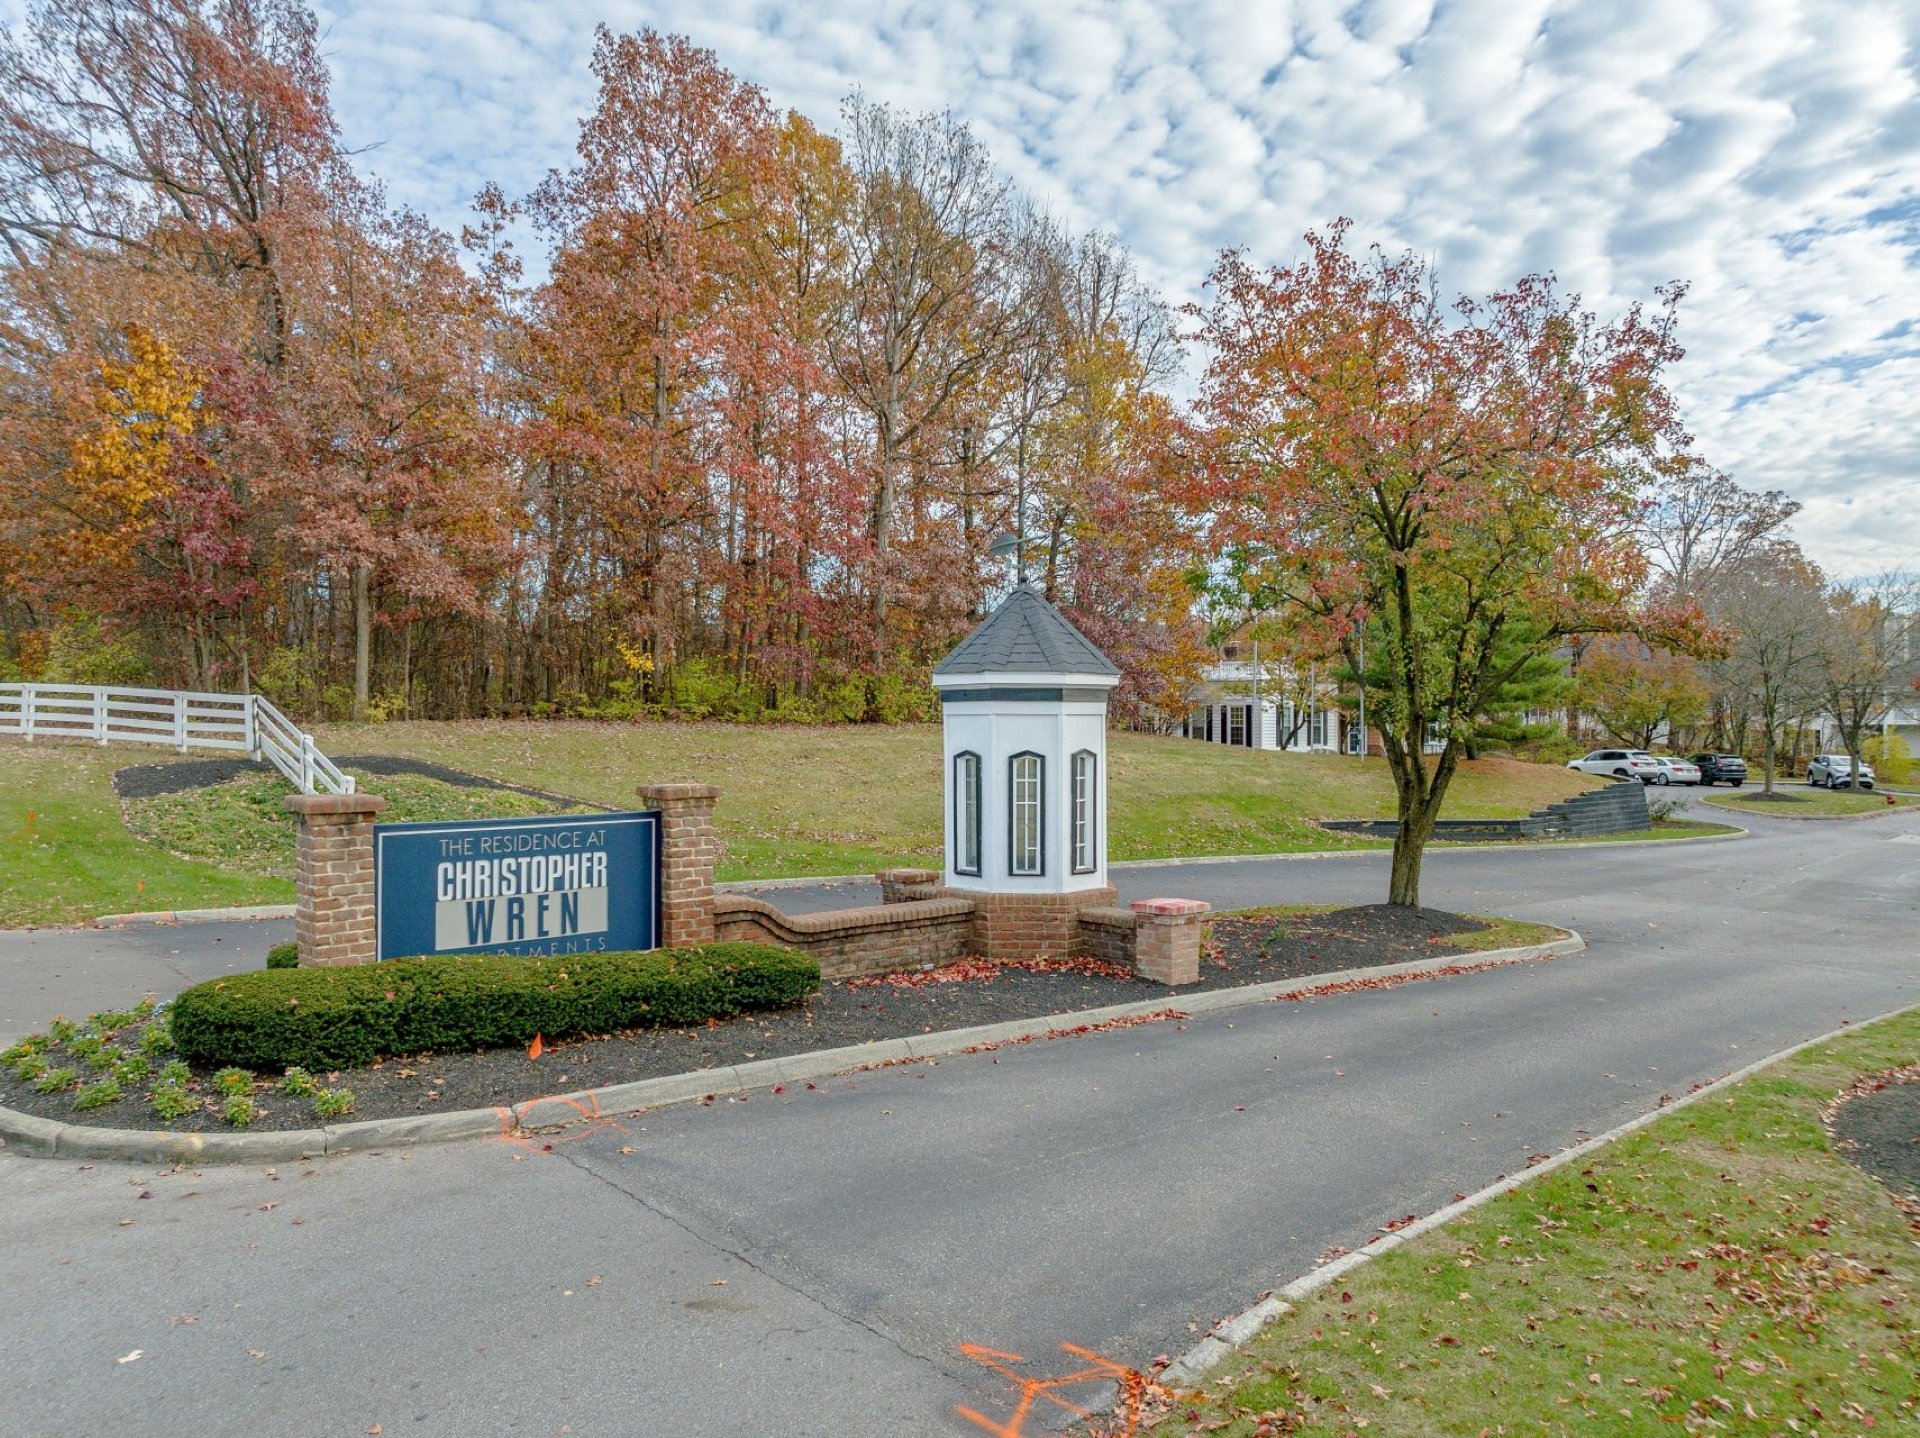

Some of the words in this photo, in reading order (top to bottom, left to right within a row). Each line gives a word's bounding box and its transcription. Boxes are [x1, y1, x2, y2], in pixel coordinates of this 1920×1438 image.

[439, 838, 474, 857] THE
[480, 831, 582, 854] RESIDENCE
[585, 830, 607, 846] AT
[437, 851, 608, 902] CHRISTOPHER
[465, 891, 579, 945] WREN
